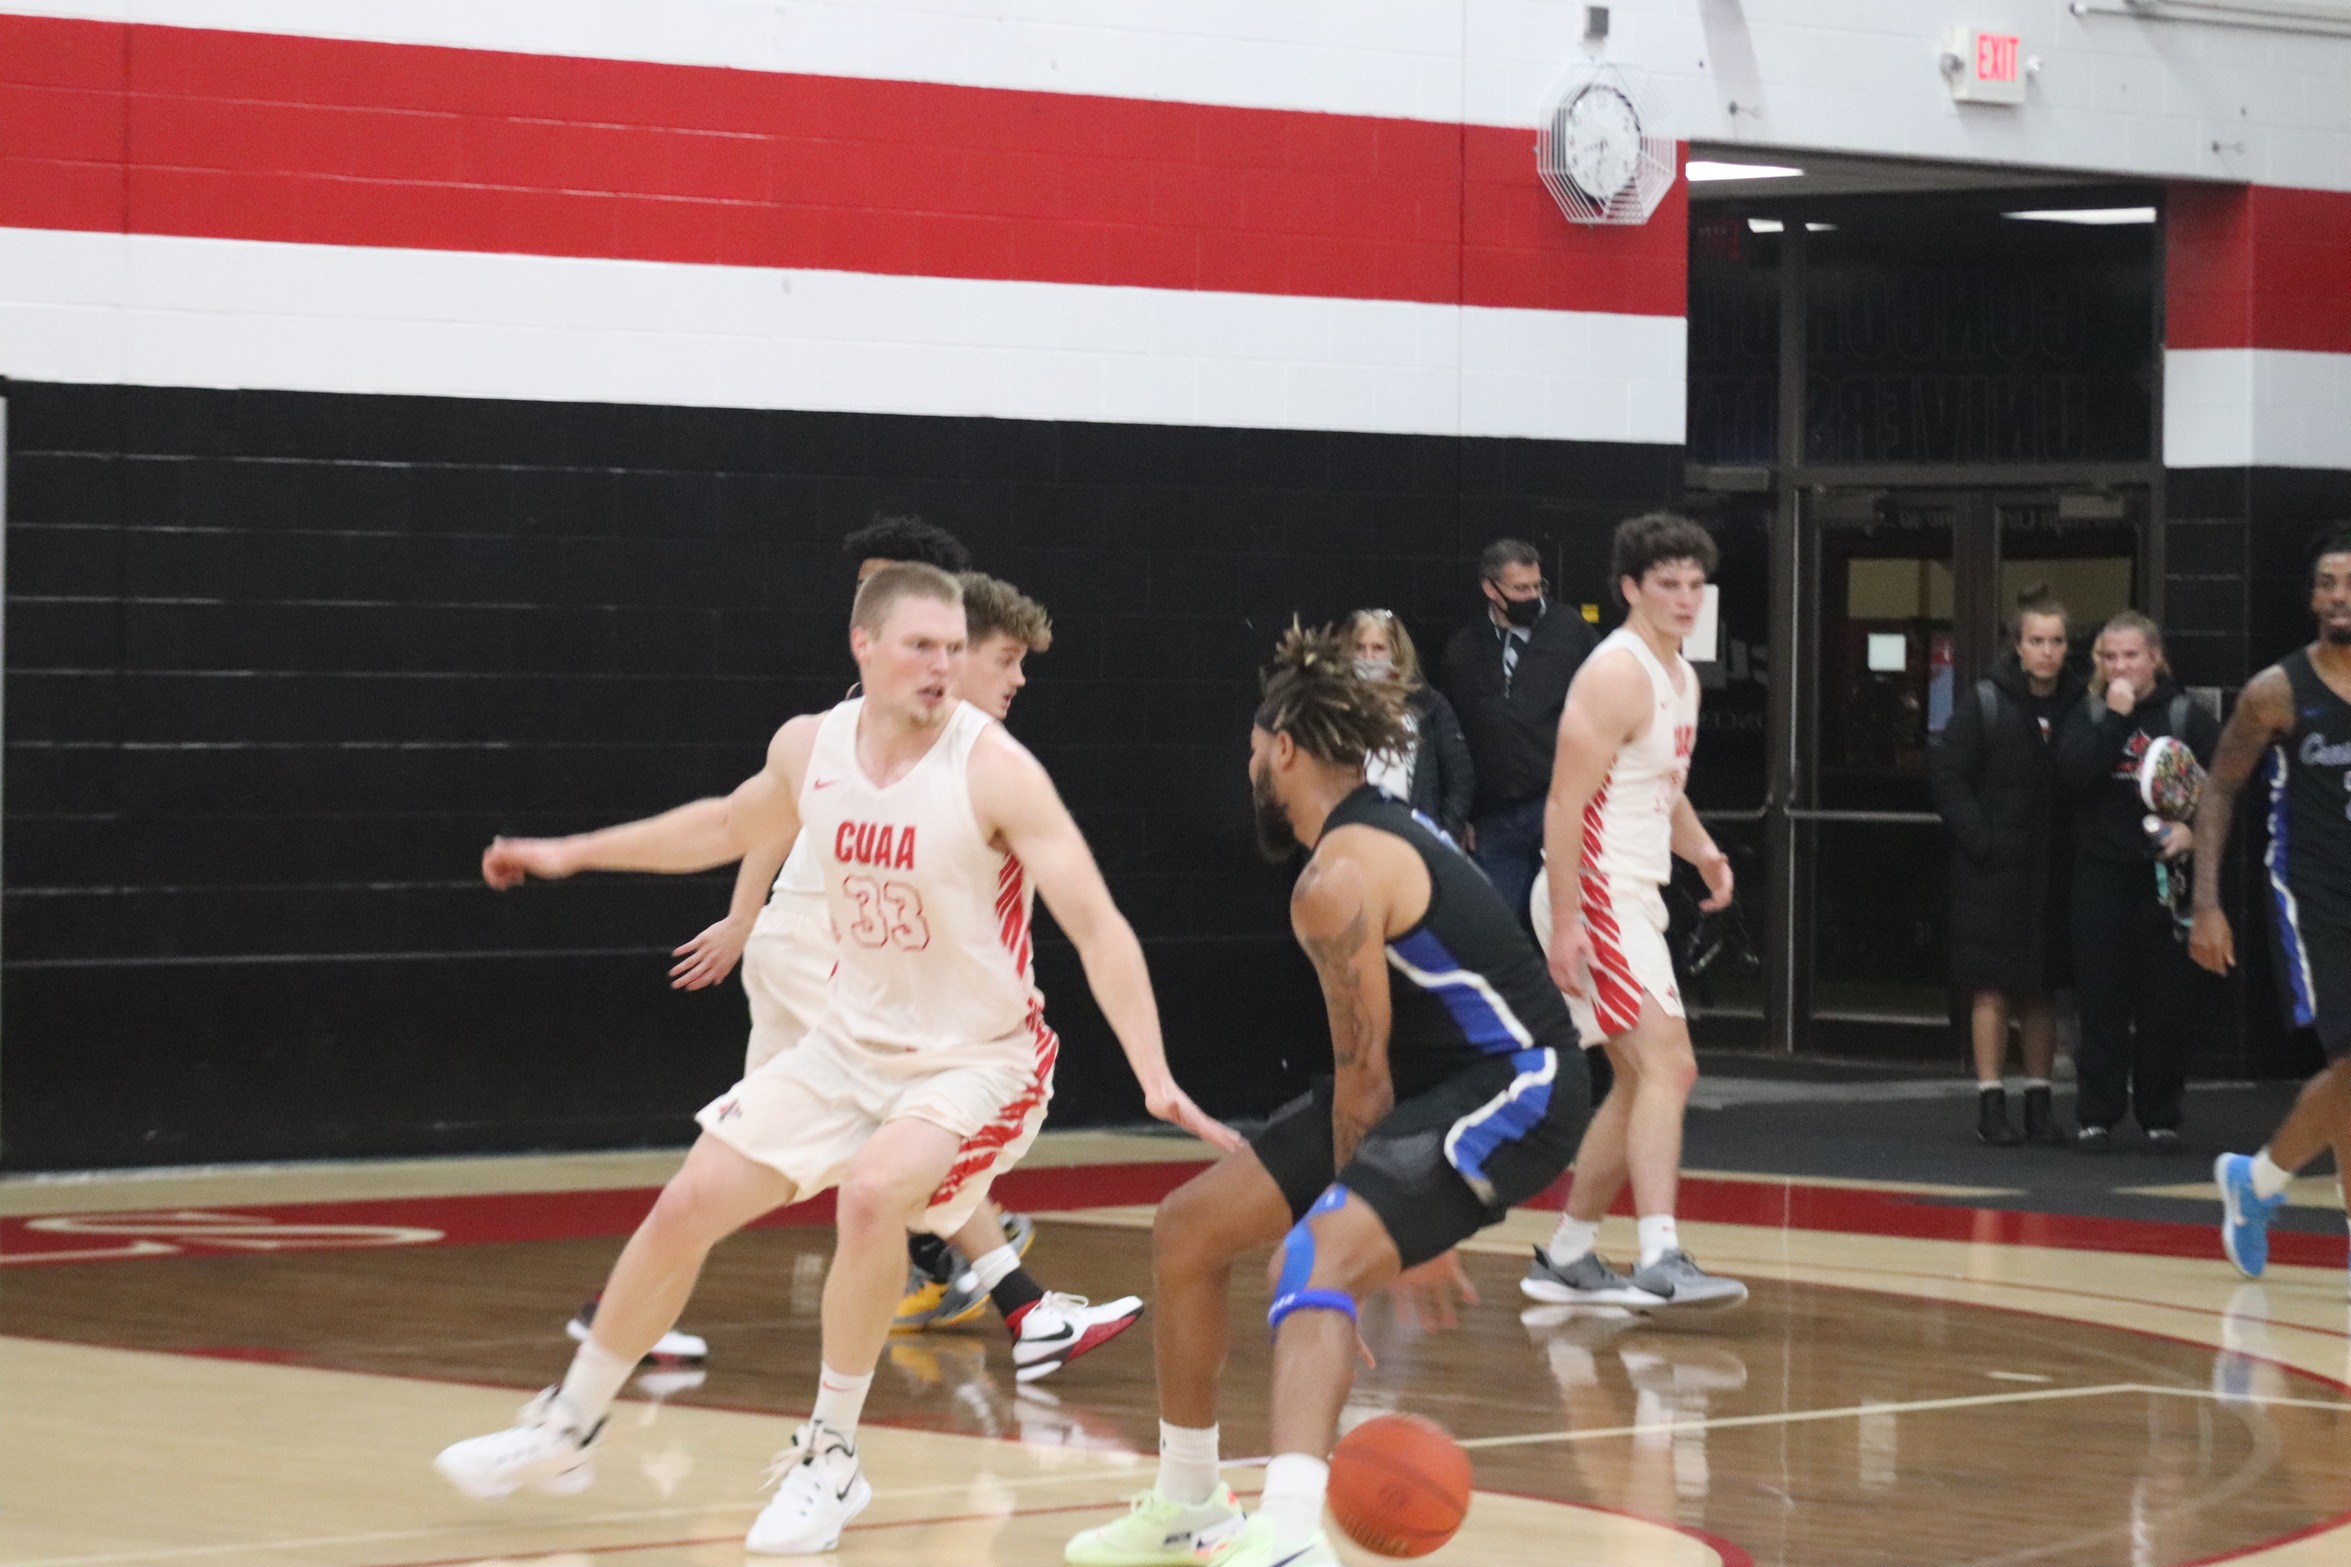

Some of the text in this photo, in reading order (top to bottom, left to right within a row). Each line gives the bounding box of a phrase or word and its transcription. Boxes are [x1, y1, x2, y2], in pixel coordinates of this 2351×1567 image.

[1976, 33, 2020, 81] EXIT
[834, 820, 917, 870] CUAA
[842, 874, 931, 952] 33
